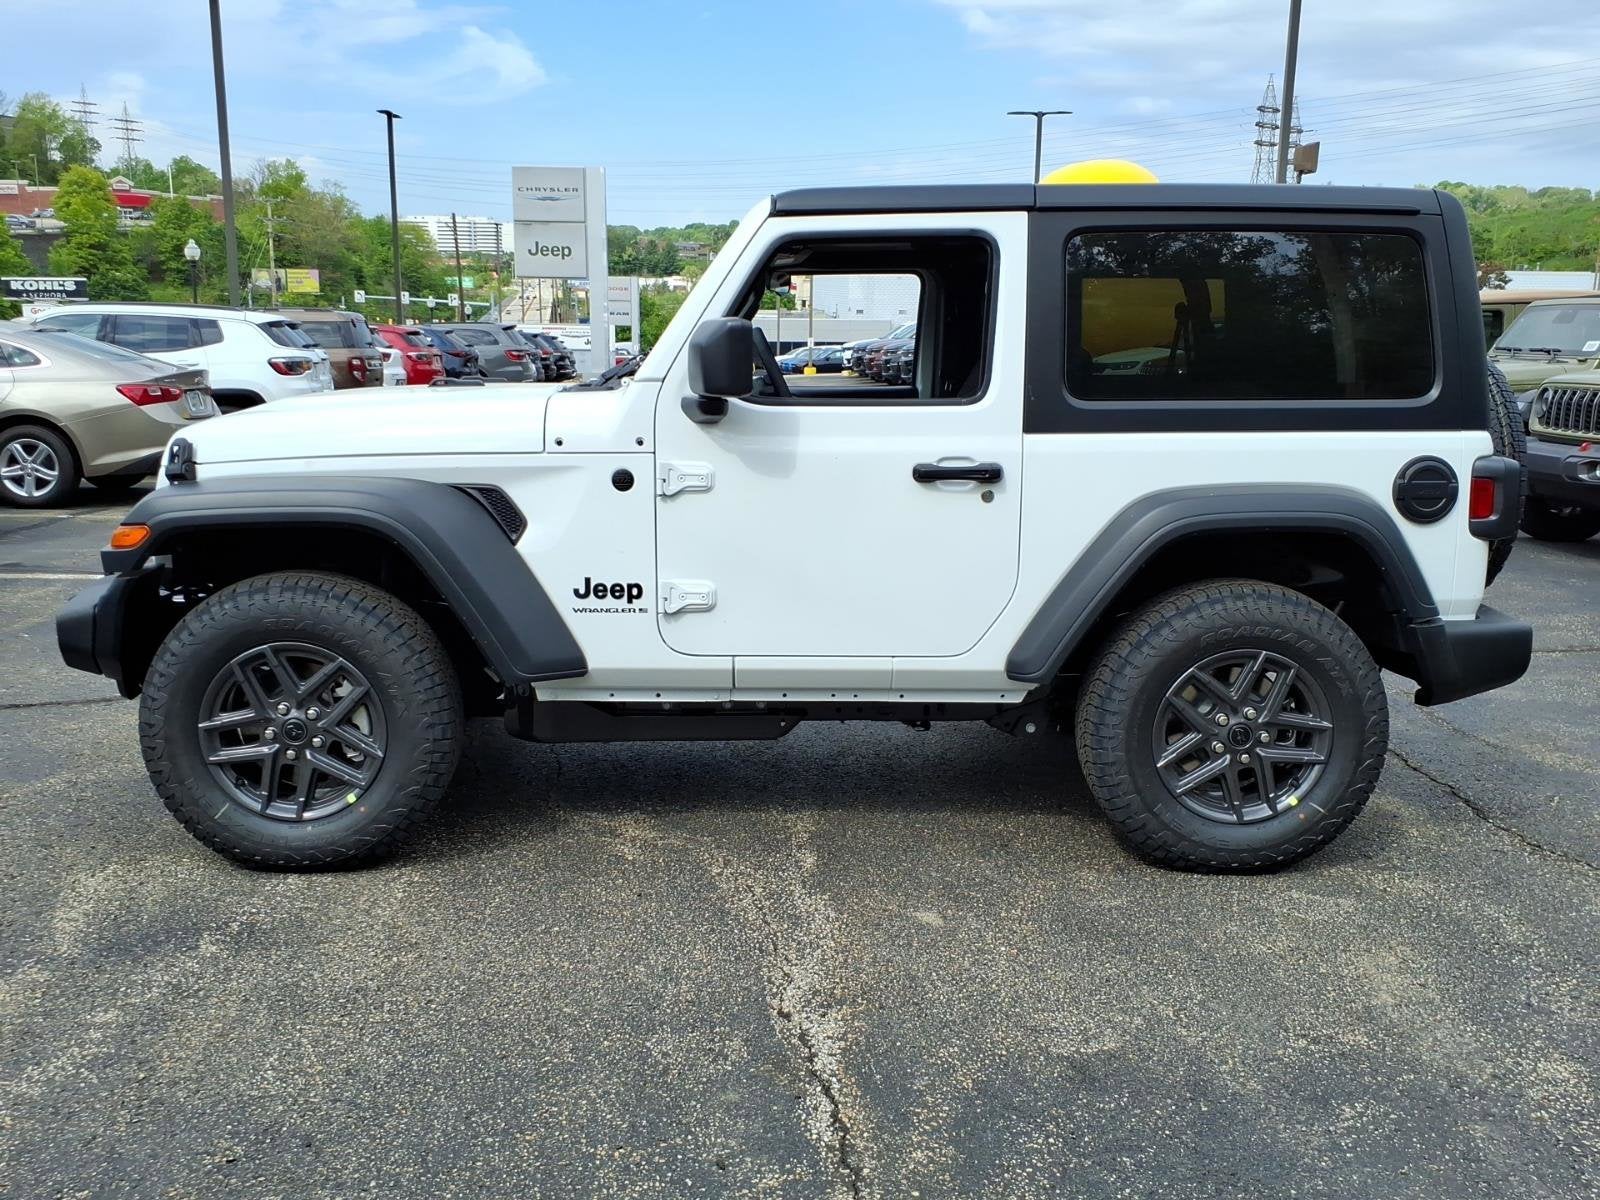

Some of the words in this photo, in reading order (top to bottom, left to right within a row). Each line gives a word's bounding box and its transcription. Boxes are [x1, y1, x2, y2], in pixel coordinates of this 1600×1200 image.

[528, 241, 572, 260] Jeep
[9, 280, 77, 291] KOHL'S
[573, 576, 643, 604] Jeep
